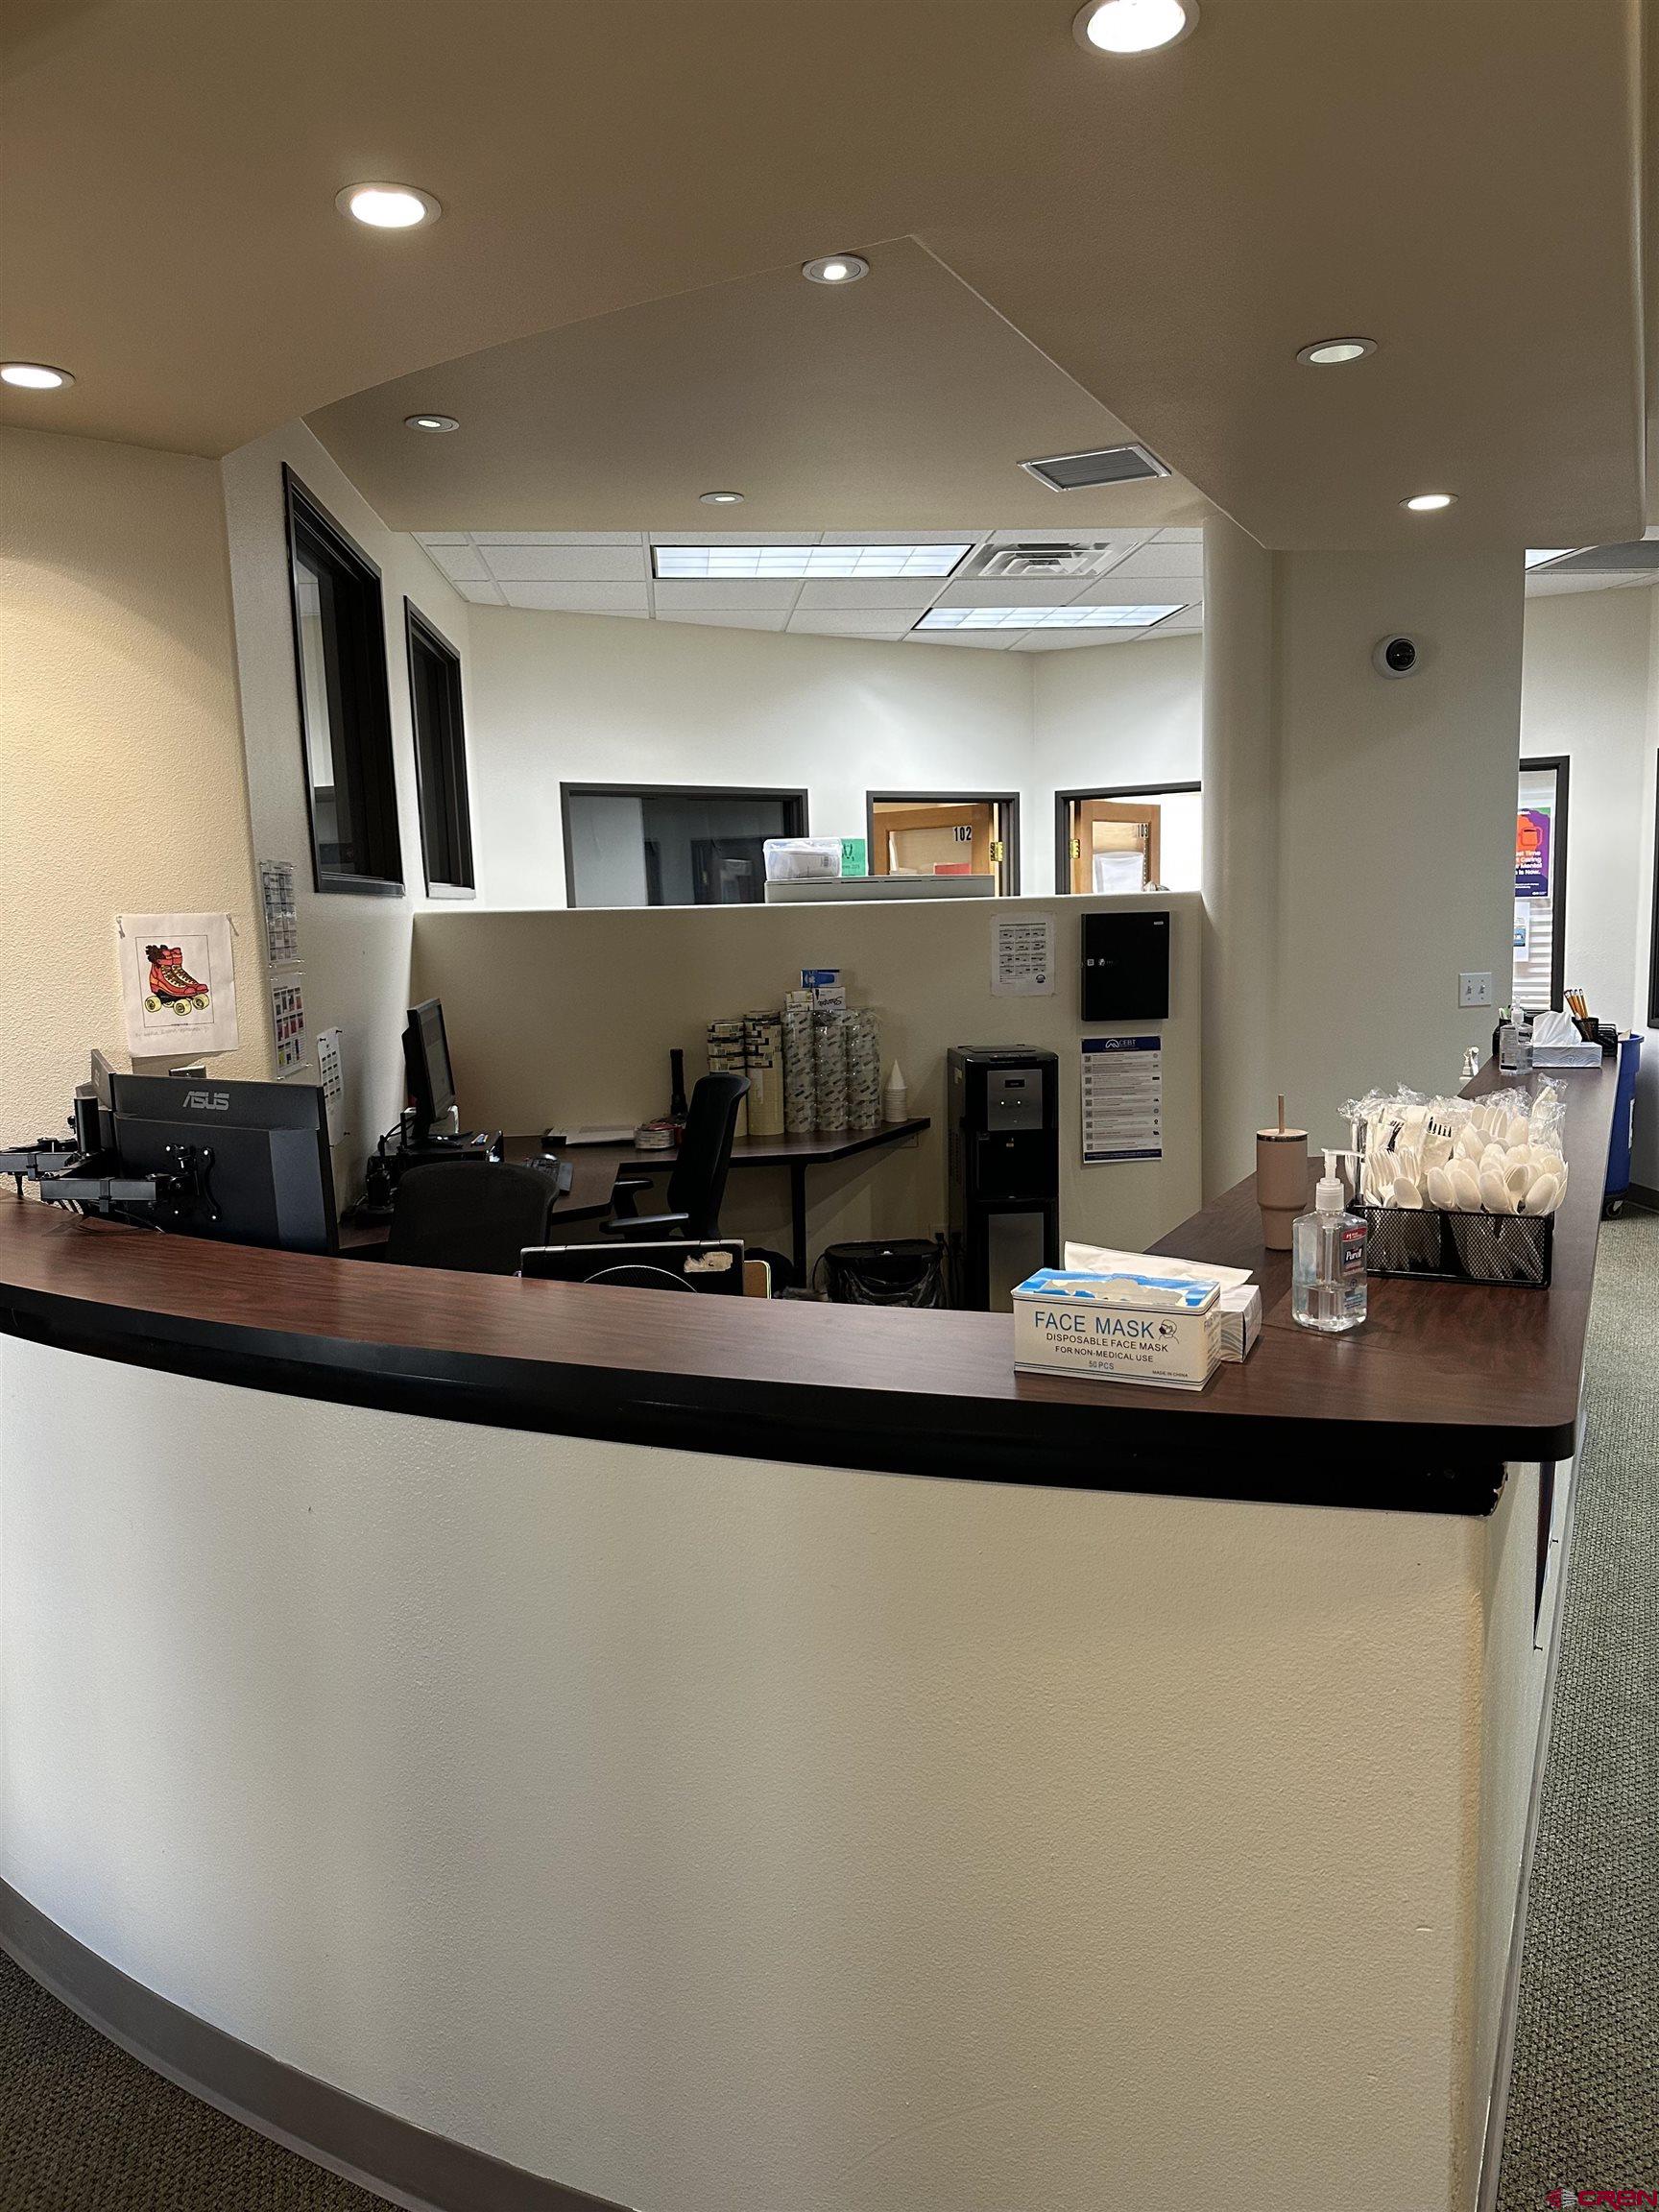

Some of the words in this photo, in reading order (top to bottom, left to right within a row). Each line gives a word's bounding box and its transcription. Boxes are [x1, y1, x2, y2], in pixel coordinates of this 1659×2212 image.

[953, 826, 972, 842] 102
[182, 1090, 230, 1111] ASUS
[1035, 1310, 1086, 1333] FACE
[1095, 1316, 1155, 1339] MASK
[1046, 1333, 1109, 1347] DISPOSABLE
[1110, 1339, 1137, 1350] FACE
[1139, 1342, 1168, 1353] MASK
[1055, 1345, 1072, 1355] FOR
[1074, 1348, 1135, 1361] NON-MEDICAL
[1089, 1359, 1097, 1368] 50
[1098, 1361, 1115, 1370] PCS
